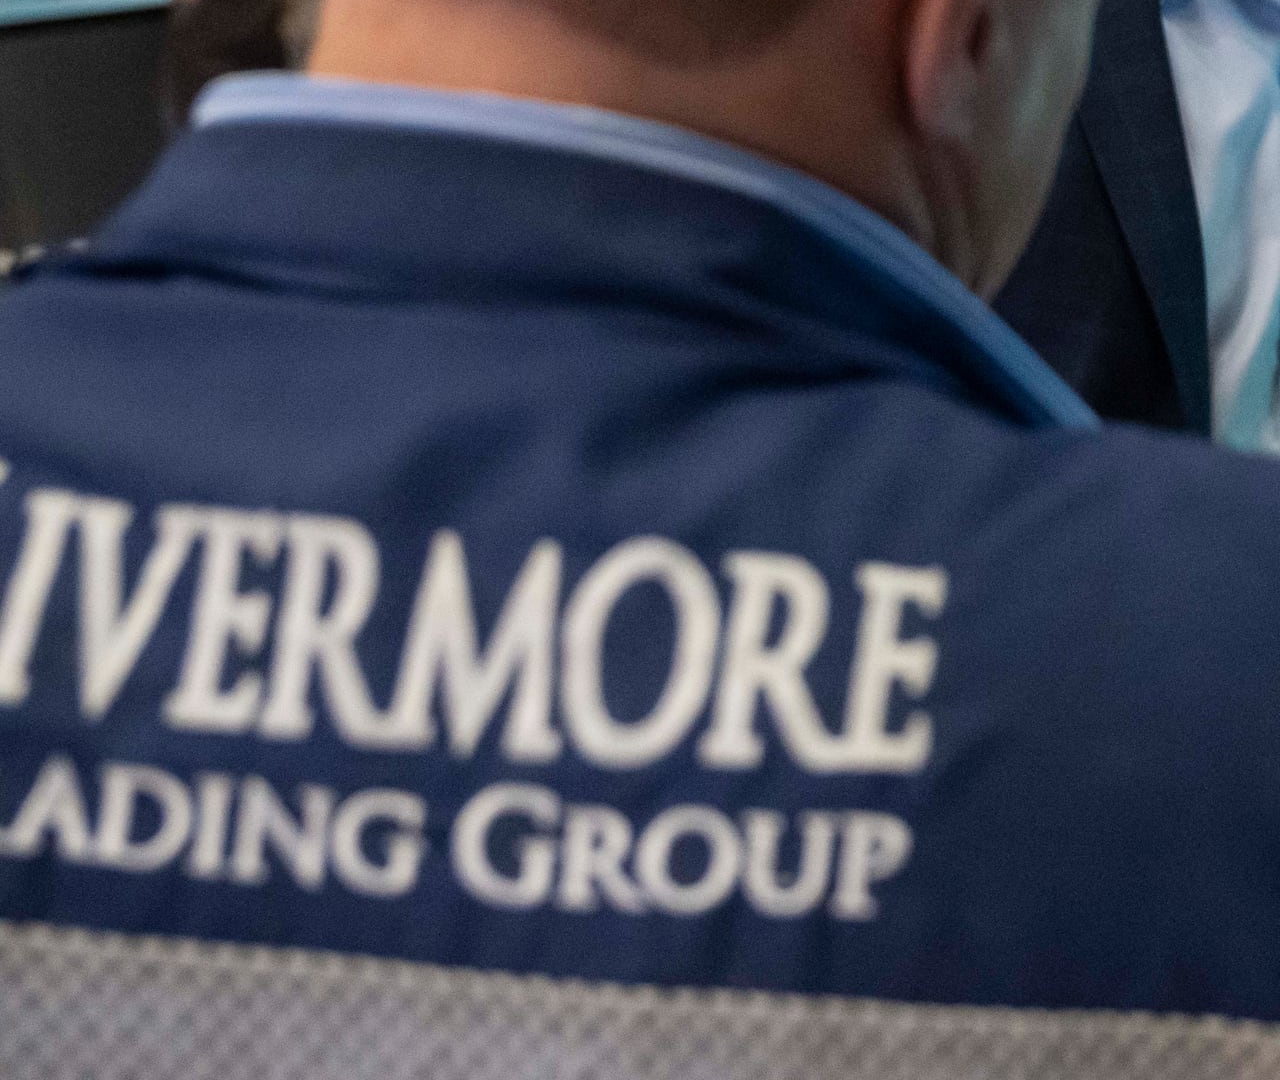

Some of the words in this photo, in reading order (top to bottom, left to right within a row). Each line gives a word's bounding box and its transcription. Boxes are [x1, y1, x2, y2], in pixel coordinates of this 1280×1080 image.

[0, 488, 948, 774] IVERMORE
[0, 755, 427, 896] ADING
[452, 781, 913, 919] GROUP
